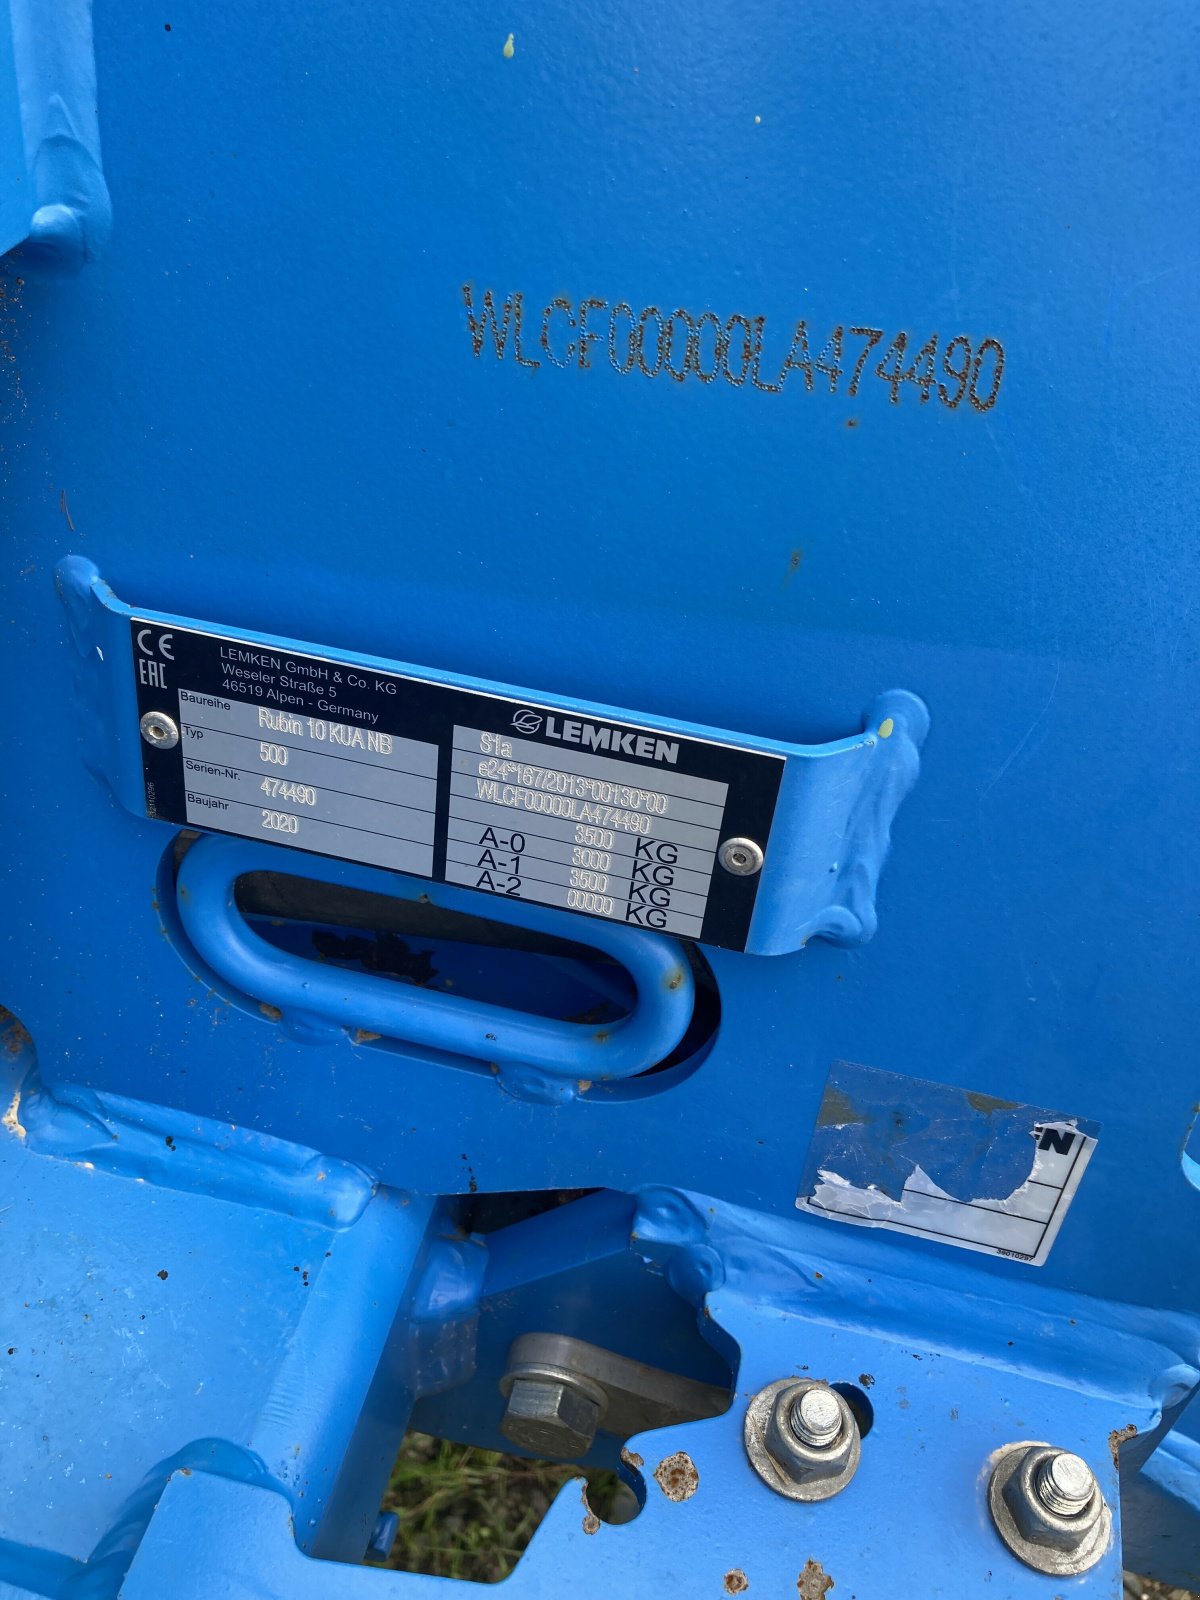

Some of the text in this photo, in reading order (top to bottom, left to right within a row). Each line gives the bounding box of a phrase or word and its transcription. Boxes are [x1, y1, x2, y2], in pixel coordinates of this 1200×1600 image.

[463, 283, 1005, 412] WLCF00000LA474490
[137, 629, 175, 661] CE
[139, 658, 168, 690] EAC
[220, 646, 397, 695] LEMKEN GmbH & Co. KG
[221, 662, 337, 698] Weseler Straße 5
[180, 690, 231, 711] Baureihe
[222, 679, 263, 697] 46519
[266, 688, 304, 706] Alpen
[317, 699, 379, 724] Germany
[184, 725, 204, 739] Typ
[258, 706, 393, 755] Rubin 10 KUA NB
[479, 731, 513, 758] S1a
[545, 716, 680, 764] LEMKEN
[185, 760, 241, 781] Serien-Nr.
[260, 741, 289, 766] 500
[187, 793, 229, 812] Baujahr
[260, 776, 316, 806] 474490
[476, 779, 652, 835] WLCF00000LA474490
[262, 808, 299, 834] 2020
[478, 826, 675, 887] A-0 3000 KG
[574, 824, 679, 865] 3500 KG
[477, 849, 671, 908] A-1 3500 KG
[475, 870, 668, 929] A-2 00000 KG
